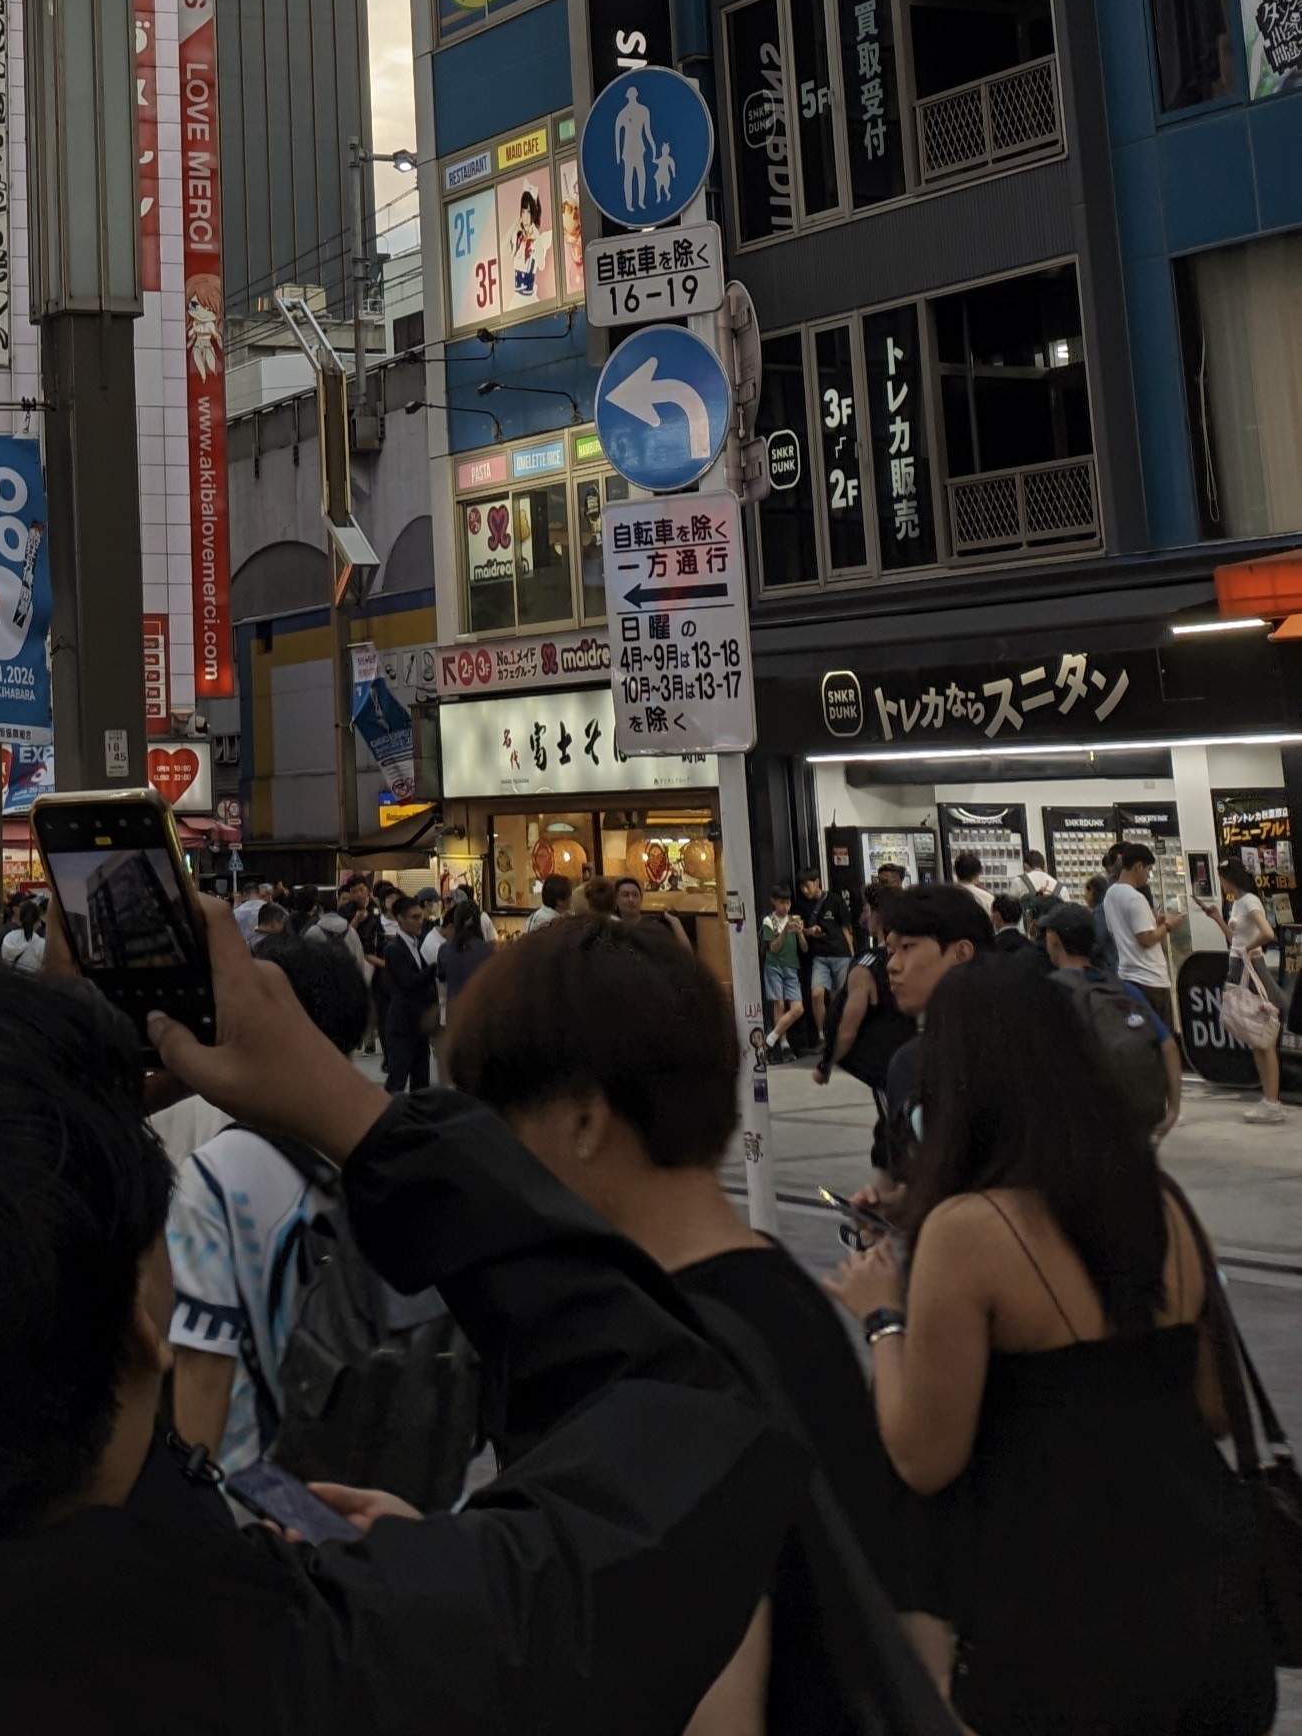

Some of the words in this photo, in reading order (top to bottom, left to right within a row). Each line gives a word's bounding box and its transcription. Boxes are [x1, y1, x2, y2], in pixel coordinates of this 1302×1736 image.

[854, 0, 888, 161] 買取受付
[186, 63, 209, 137] LOVE
[801, 79, 831, 118] 5F
[505, 141, 523, 163] MAID
[524, 136, 540, 156] CAFE
[448, 156, 489, 187] RESTAURANT
[188, 150, 213, 251] MERCI
[454, 207, 475, 259] 2F
[597, 239, 710, 282] 自転車を除く
[476, 257, 498, 309] 3F
[608, 274, 699, 316] 16-19
[824, 388, 852, 429] 3F
[771, 445, 795, 461] SNKR
[886, 336, 920, 541] トレカ販売
[471, 462, 492, 483] PASTA
[772, 459, 797, 475] DUNK
[829, 468, 859, 510] 2F
[198, 395, 221, 681] www.akibalovemerci.com
[613, 514, 728, 549] 自転車を除く
[618, 546, 729, 579] 一方通行
[622, 615, 697, 642] 日曜の
[827, 690, 856, 704] SNKR
[829, 705, 858, 721] DUNK
[875, 651, 1130, 741] トレカならスニダン
[629, 707, 687, 734] を除く
[114, 752, 127, 762] 45
[1065, 819, 1105, 827] SNKRDUNK
[1223, 819, 1292, 845] リニューアル!
